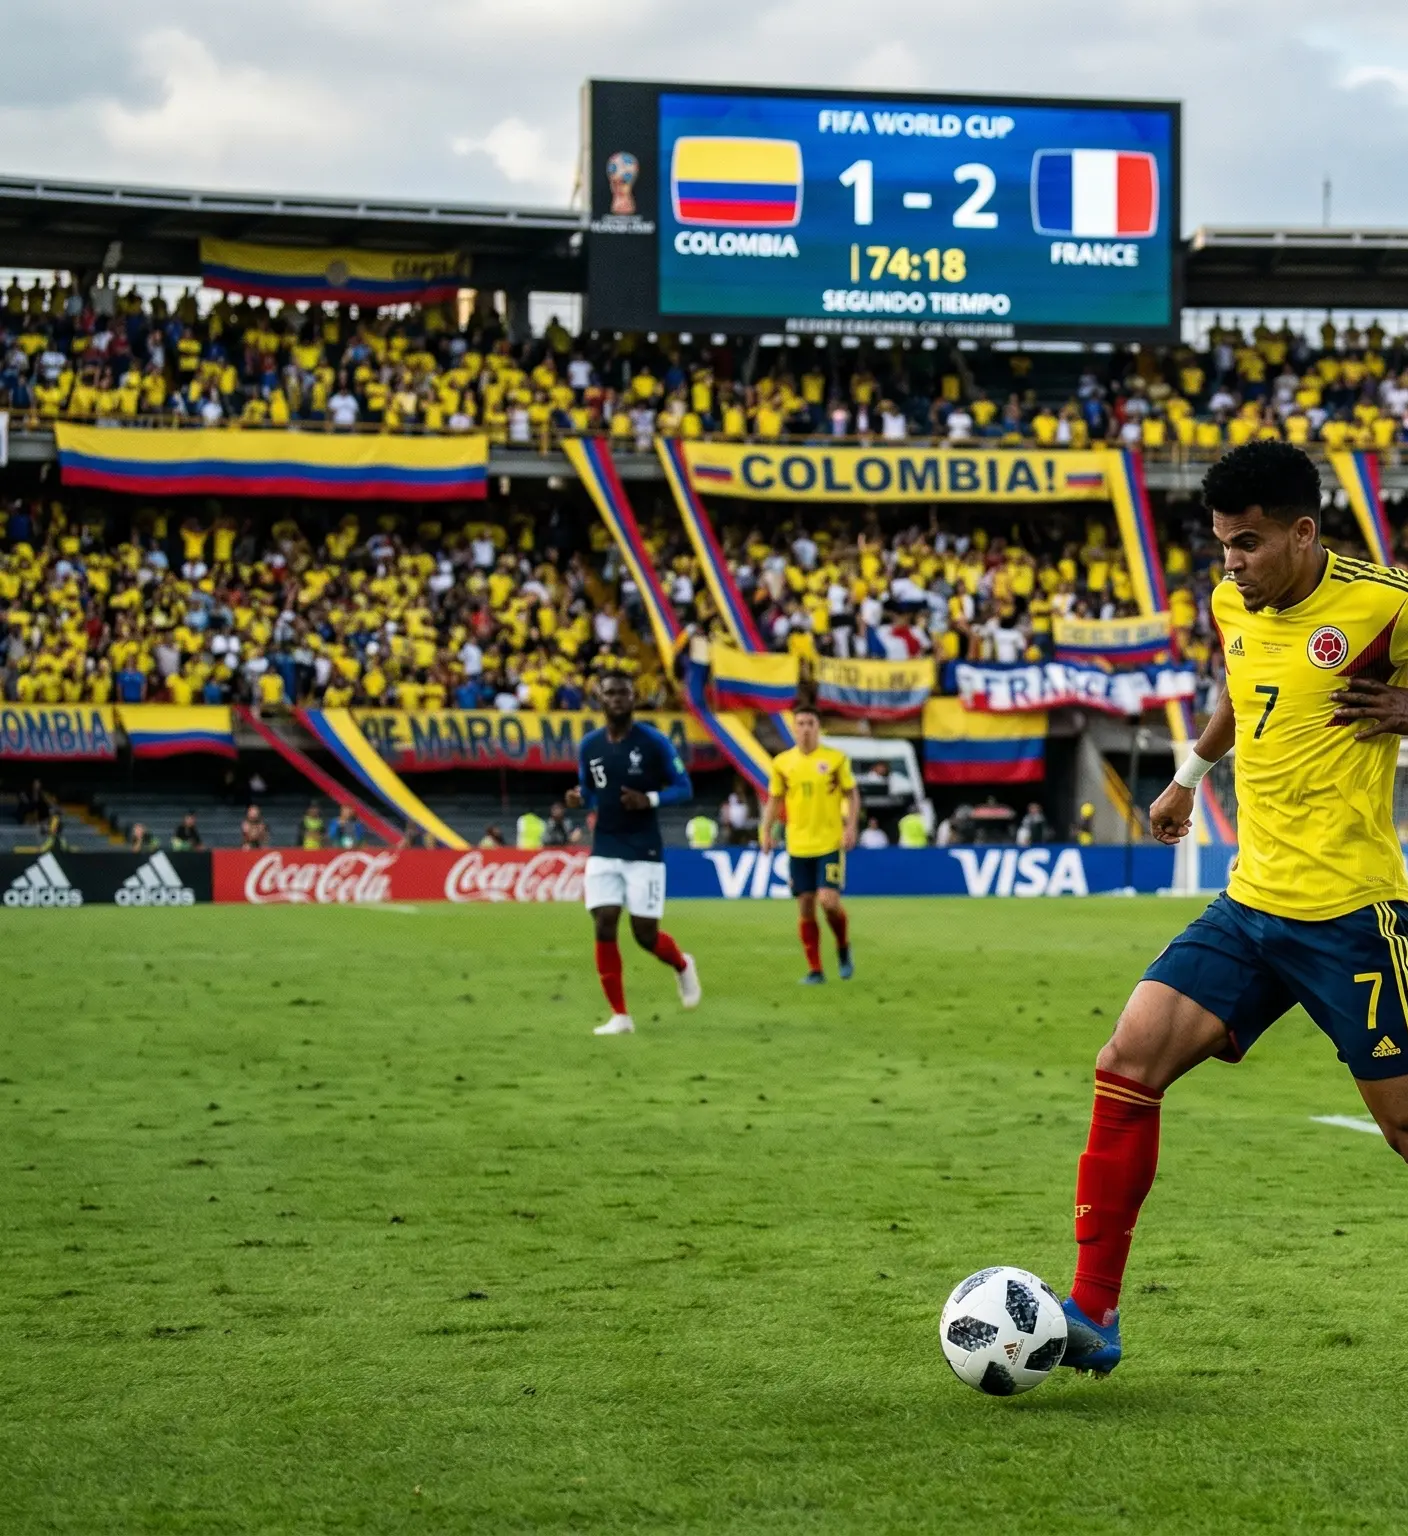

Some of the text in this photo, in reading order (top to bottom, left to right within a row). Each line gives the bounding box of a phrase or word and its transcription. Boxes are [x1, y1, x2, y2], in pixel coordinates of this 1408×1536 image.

[818, 109, 1015, 139] FIFA WORLD CUP
[838, 159, 874, 226] 1
[952, 162, 999, 229] 2
[674, 230, 800, 257] COLOMBIA
[1050, 241, 1139, 267] FRANCE
[866, 245, 967, 283] 74:18
[822, 289, 1011, 315] SEGUNDO TIEMPO
[740, 453, 1056, 493] COLOMBIA!
[1254, 684, 1279, 739] 7
[0, 710, 113, 753] OMBIA
[702, 850, 793, 899] VIS
[948, 848, 1089, 898] VISA
[3, 883, 83, 908] adidas
[115, 882, 196, 907] adidas
[1354, 972, 1382, 1029] 7
